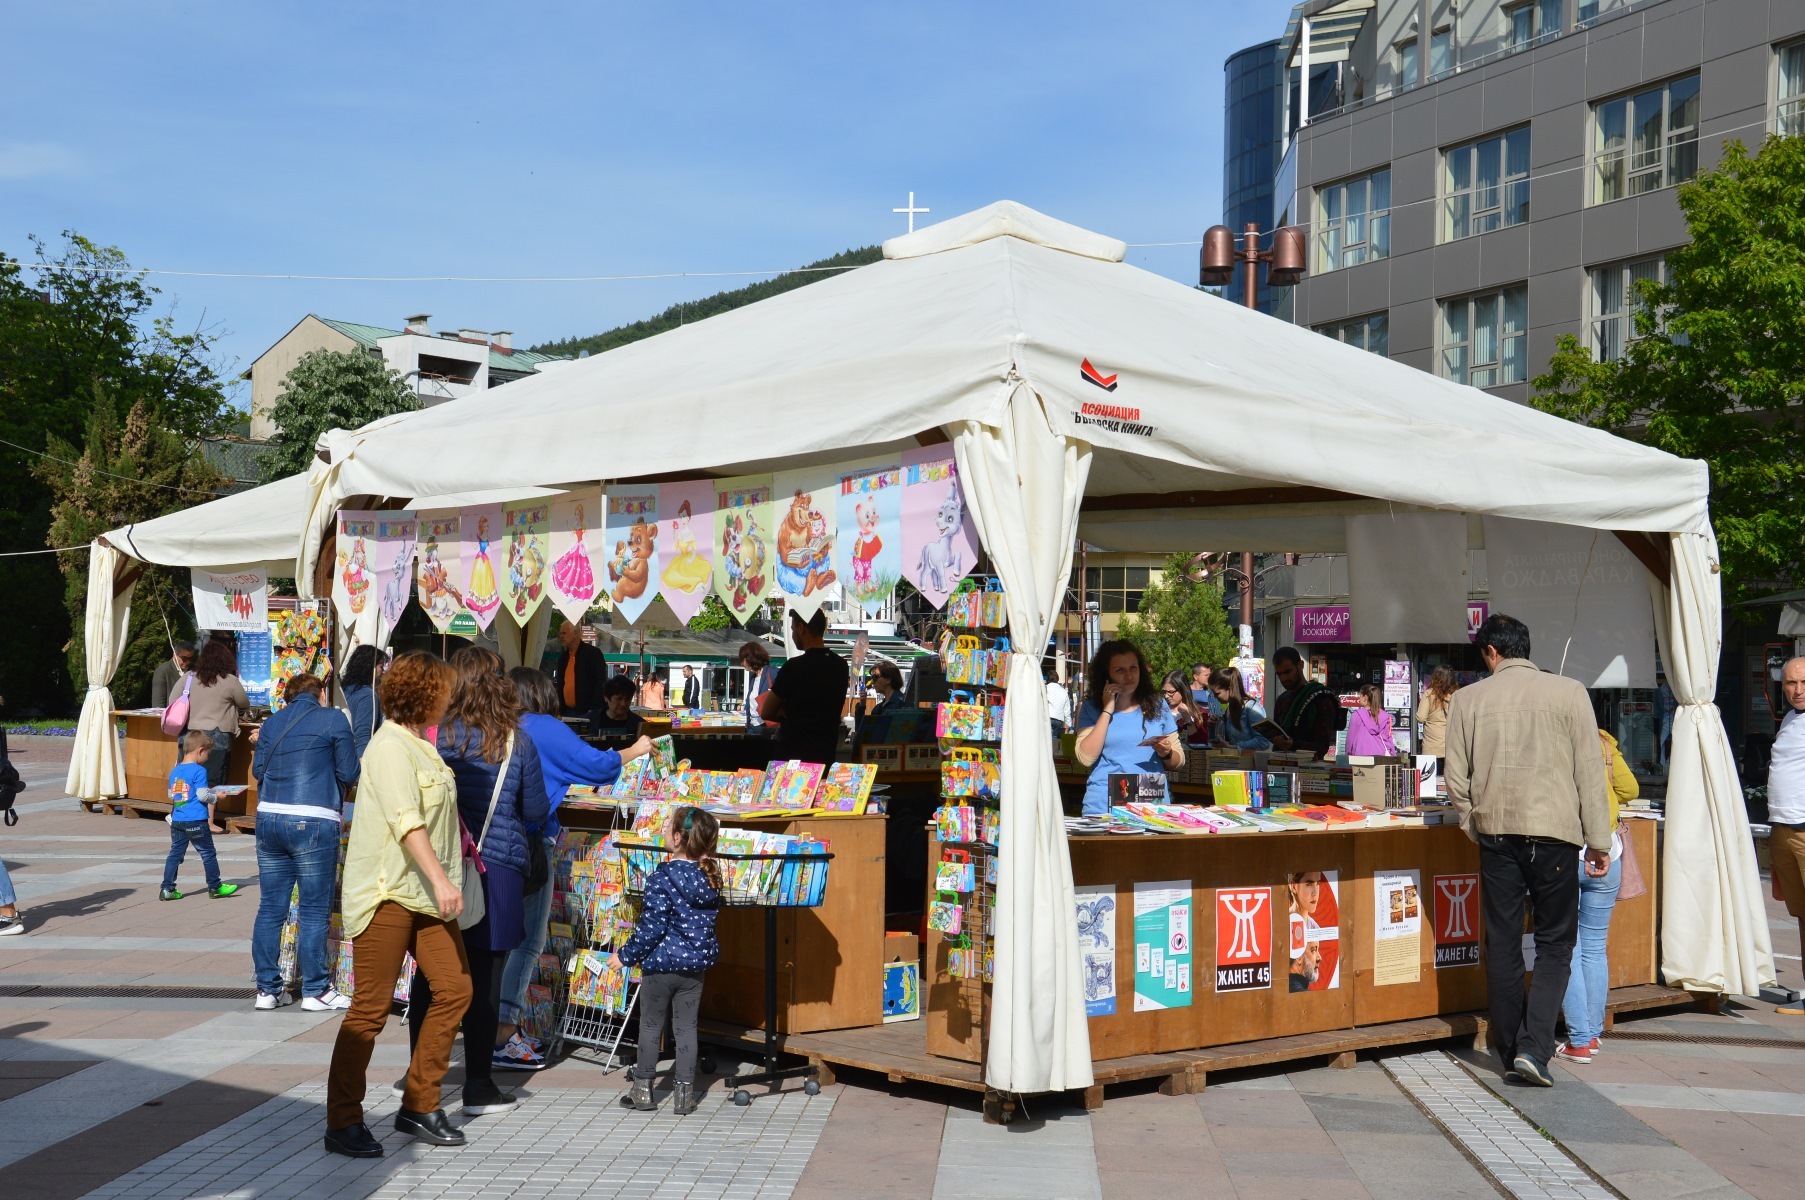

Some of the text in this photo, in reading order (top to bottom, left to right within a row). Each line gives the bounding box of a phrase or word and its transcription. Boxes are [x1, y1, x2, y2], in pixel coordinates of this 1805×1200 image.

[1081, 402, 1140, 421] АСОЦИАЦИЯ
[1302, 628, 1338, 636] BOOKSTORE
[1436, 947, 1466, 963] ЖАНЕТ
[1468, 945, 1478, 959] 45
[1217, 967, 1269, 986] ЖАНЕТ 45
